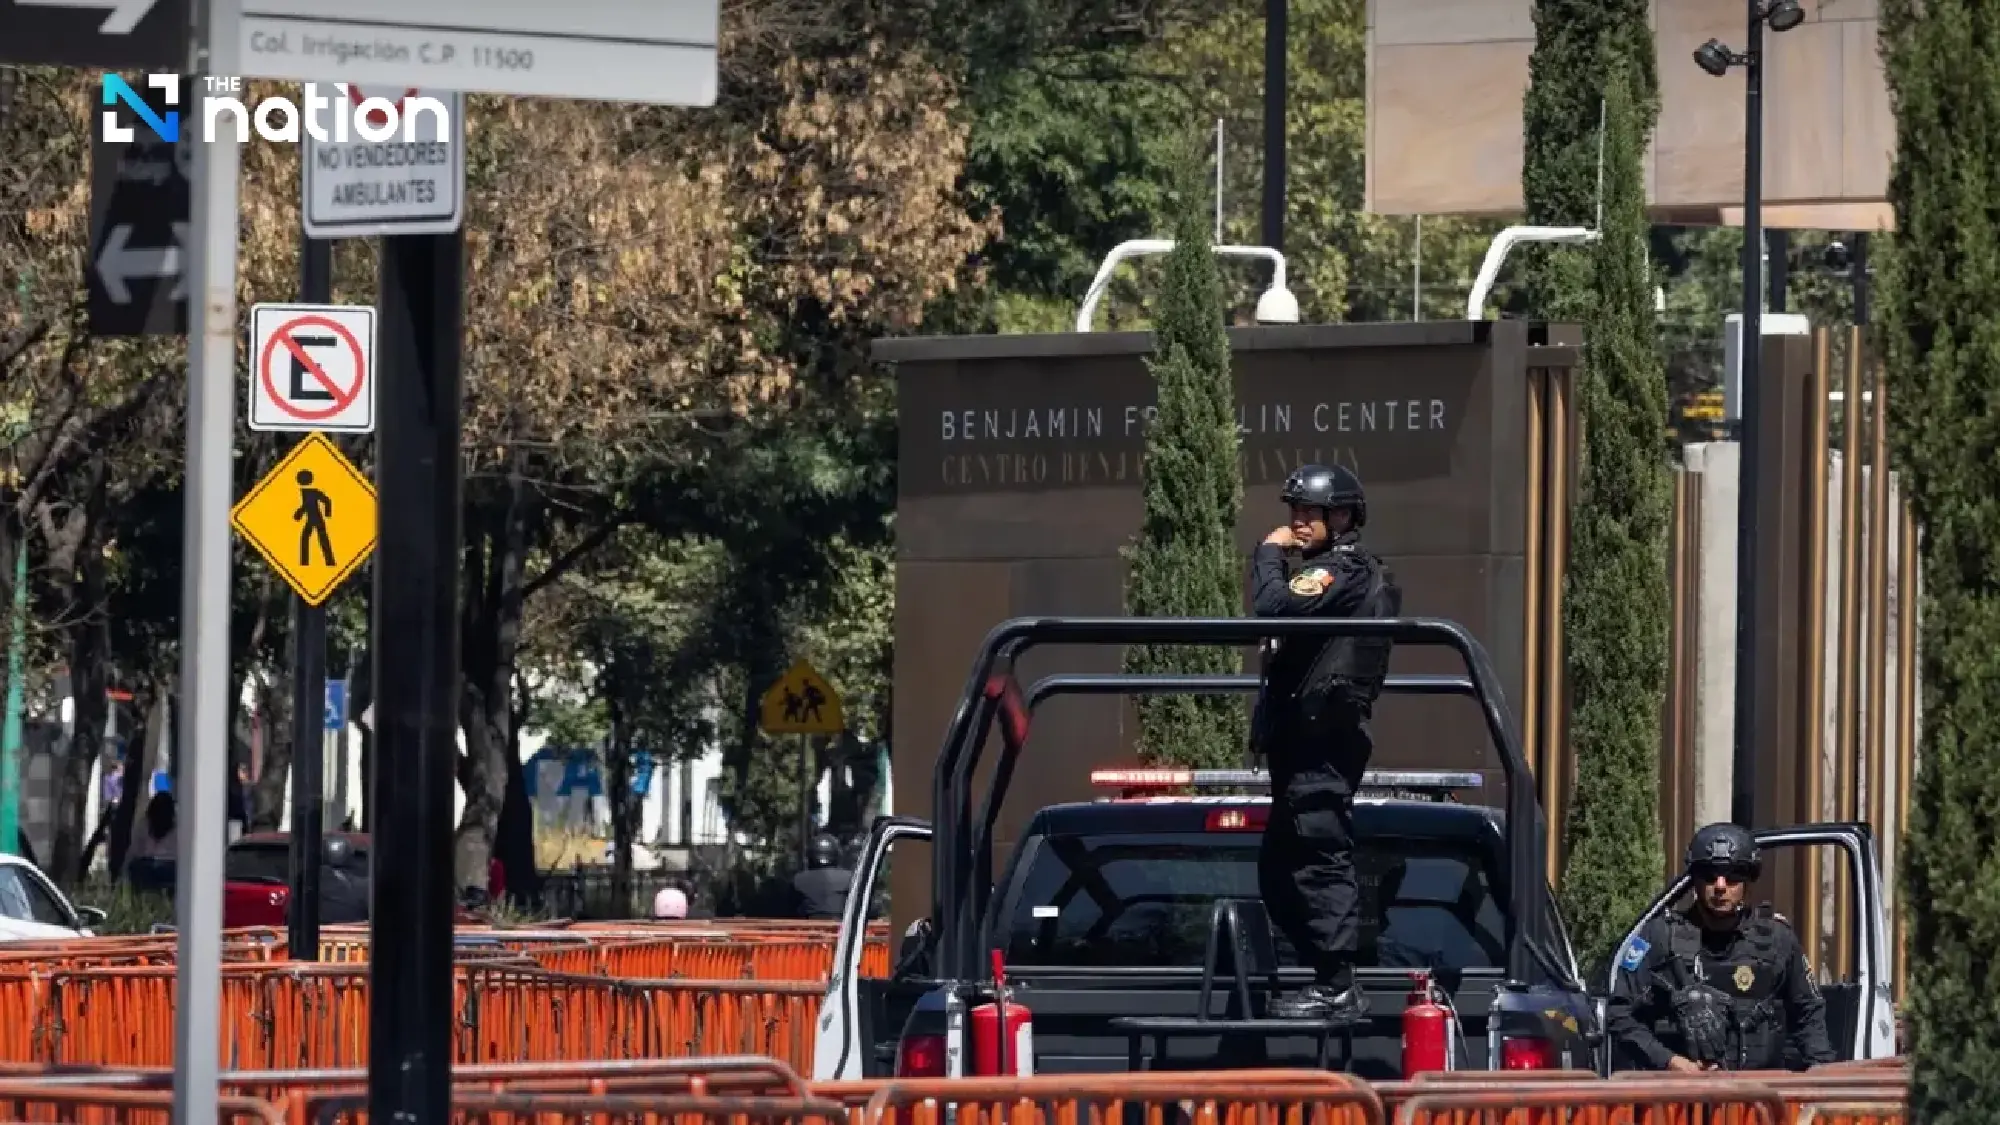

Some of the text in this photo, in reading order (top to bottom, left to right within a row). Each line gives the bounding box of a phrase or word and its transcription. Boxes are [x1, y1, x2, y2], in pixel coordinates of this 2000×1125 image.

[473, 46, 536, 70] 11500
[317, 141, 447, 170] NO VENDEDORES
[332, 179, 436, 206] AMBULANTES
[942, 399, 1446, 440] BENJAMIN FRLIN CENTER
[942, 453, 1047, 484] CENTRO
